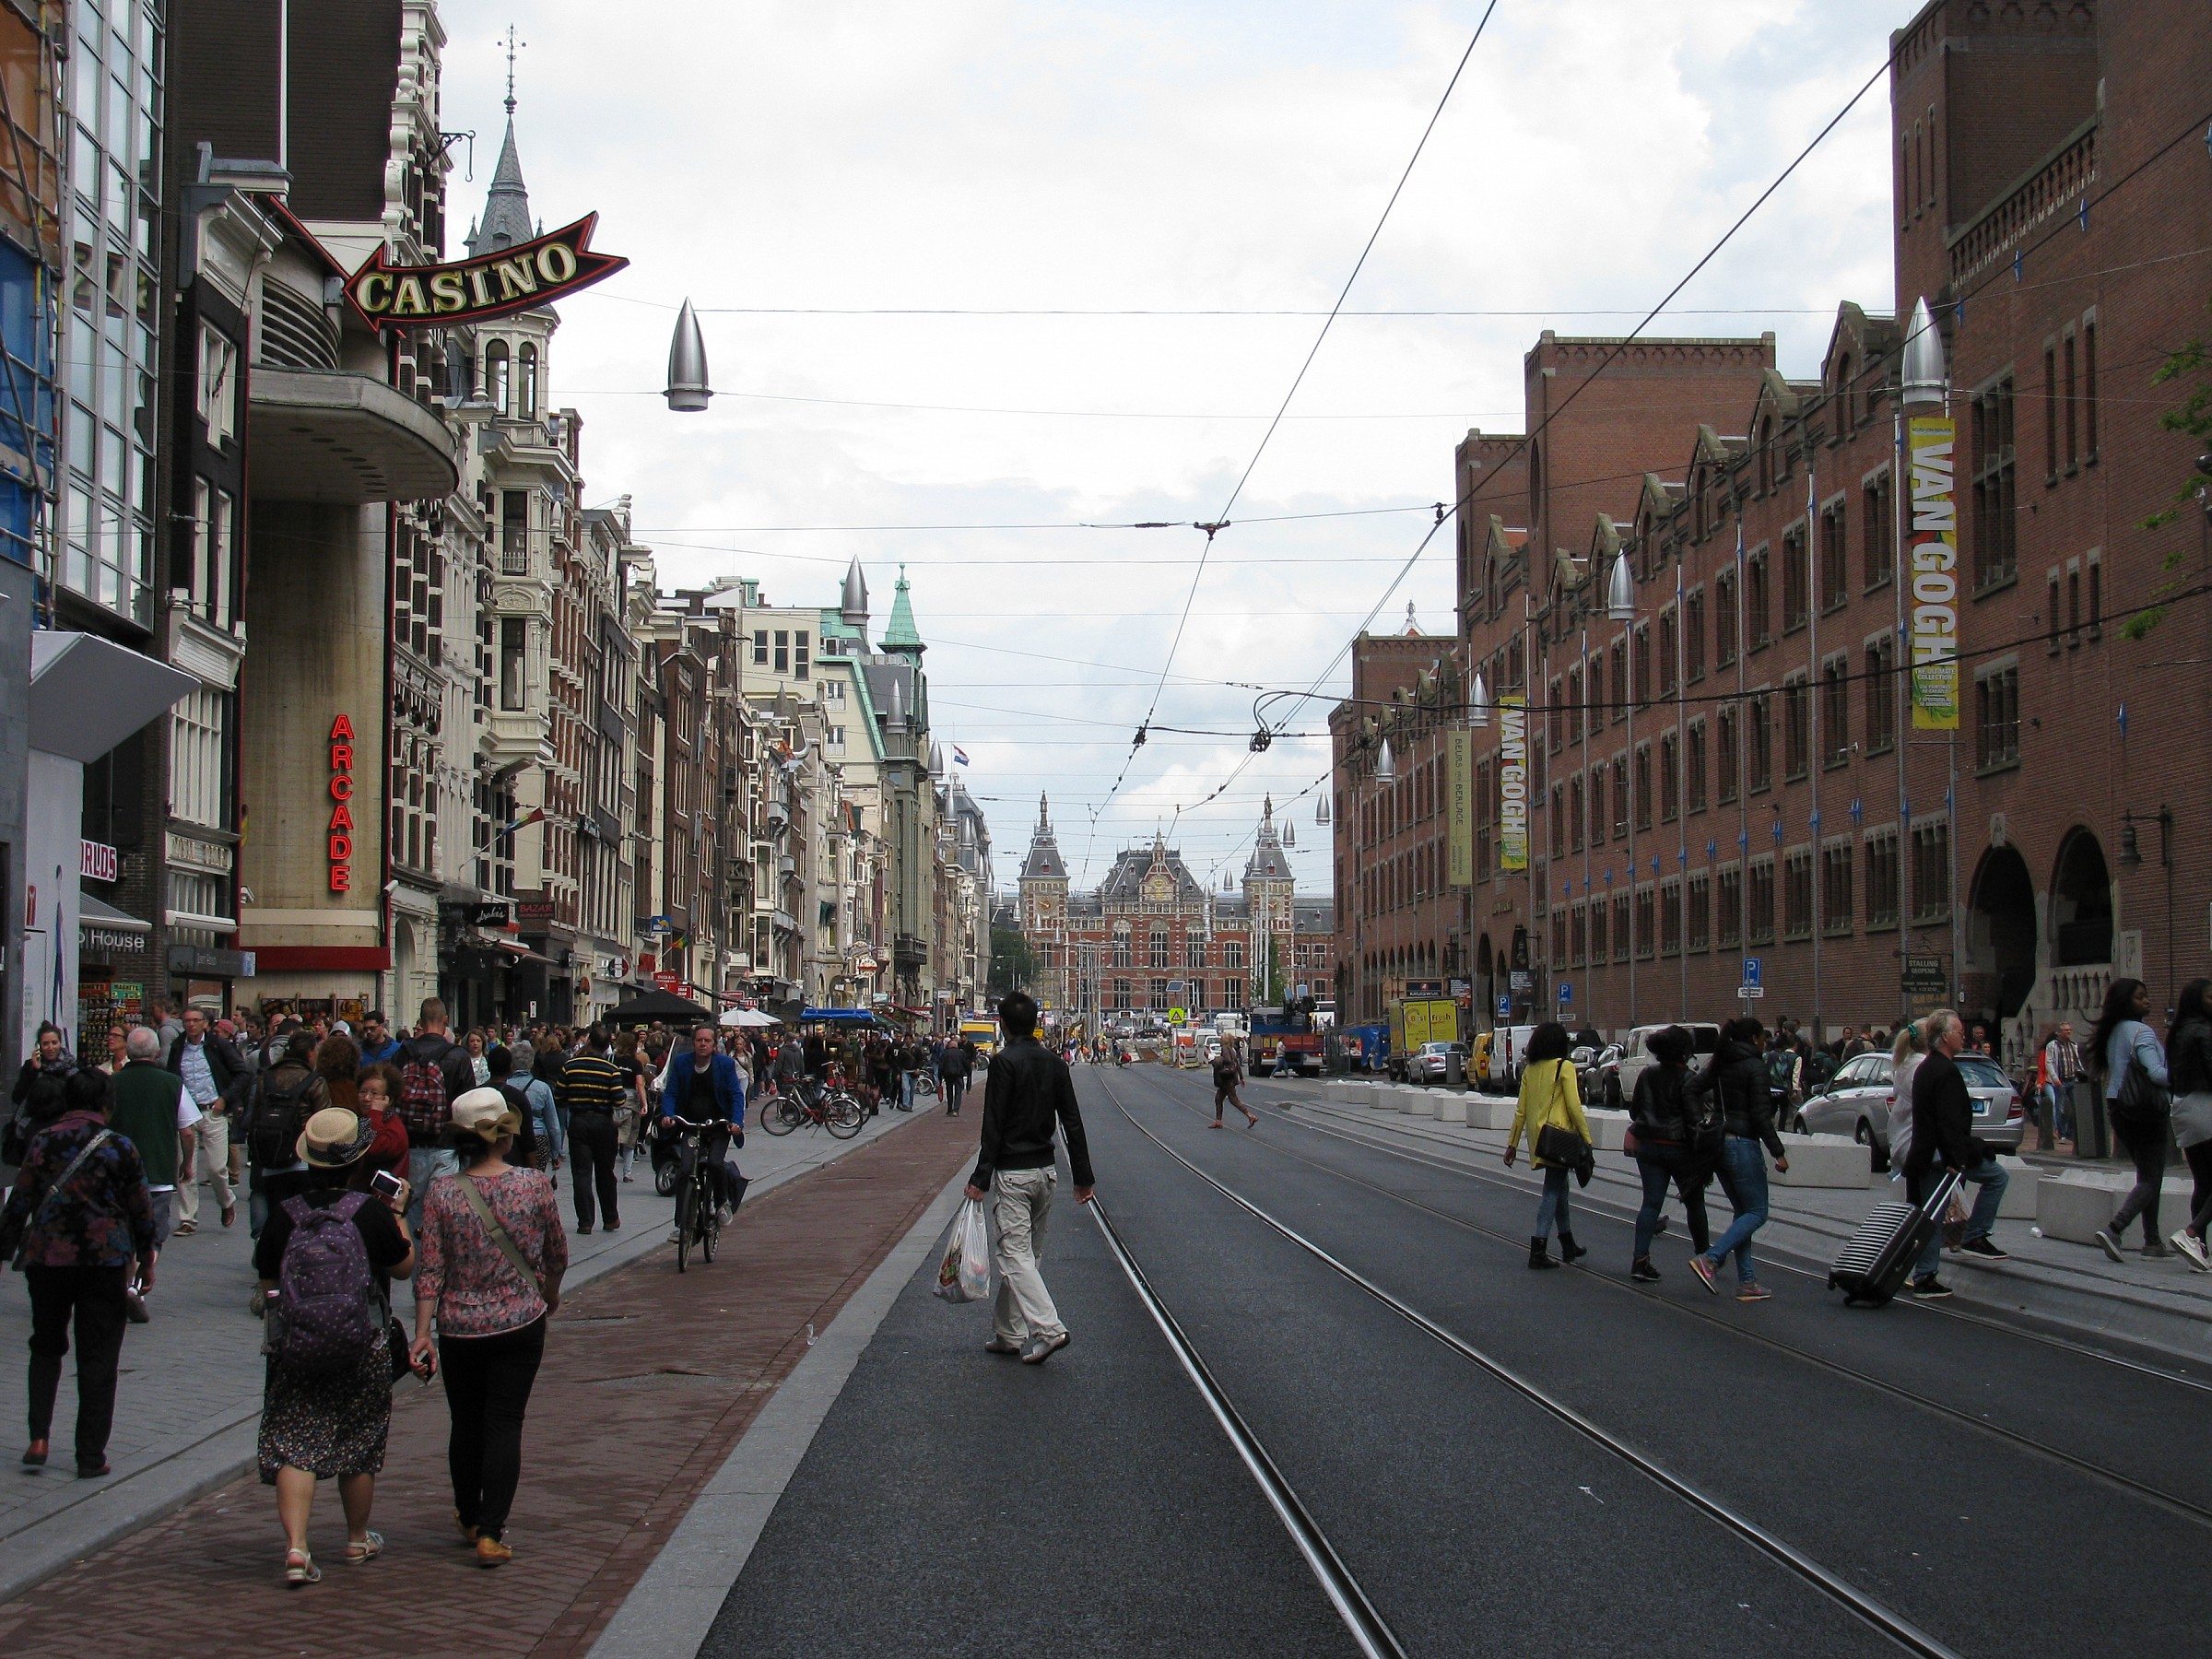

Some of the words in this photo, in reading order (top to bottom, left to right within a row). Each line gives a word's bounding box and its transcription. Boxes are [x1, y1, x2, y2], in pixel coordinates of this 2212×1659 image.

[356, 242, 577, 315] CASINO
[1911, 441, 1954, 531] VAN
[1912, 542, 1957, 667] GOGH
[1454, 738, 1463, 768] BEURS
[1501, 708, 1525, 759] VAN
[329, 714, 355, 890] ARCADE
[1455, 783, 1464, 826] BERLAGE
[1501, 765, 1526, 834] GOGH
[519, 903, 553, 912] BAZAR
[91, 934, 146, 949] House
[1560, 984, 1569, 995] P
[1747, 961, 1756, 975] P
[1500, 997, 1507, 1007] P
